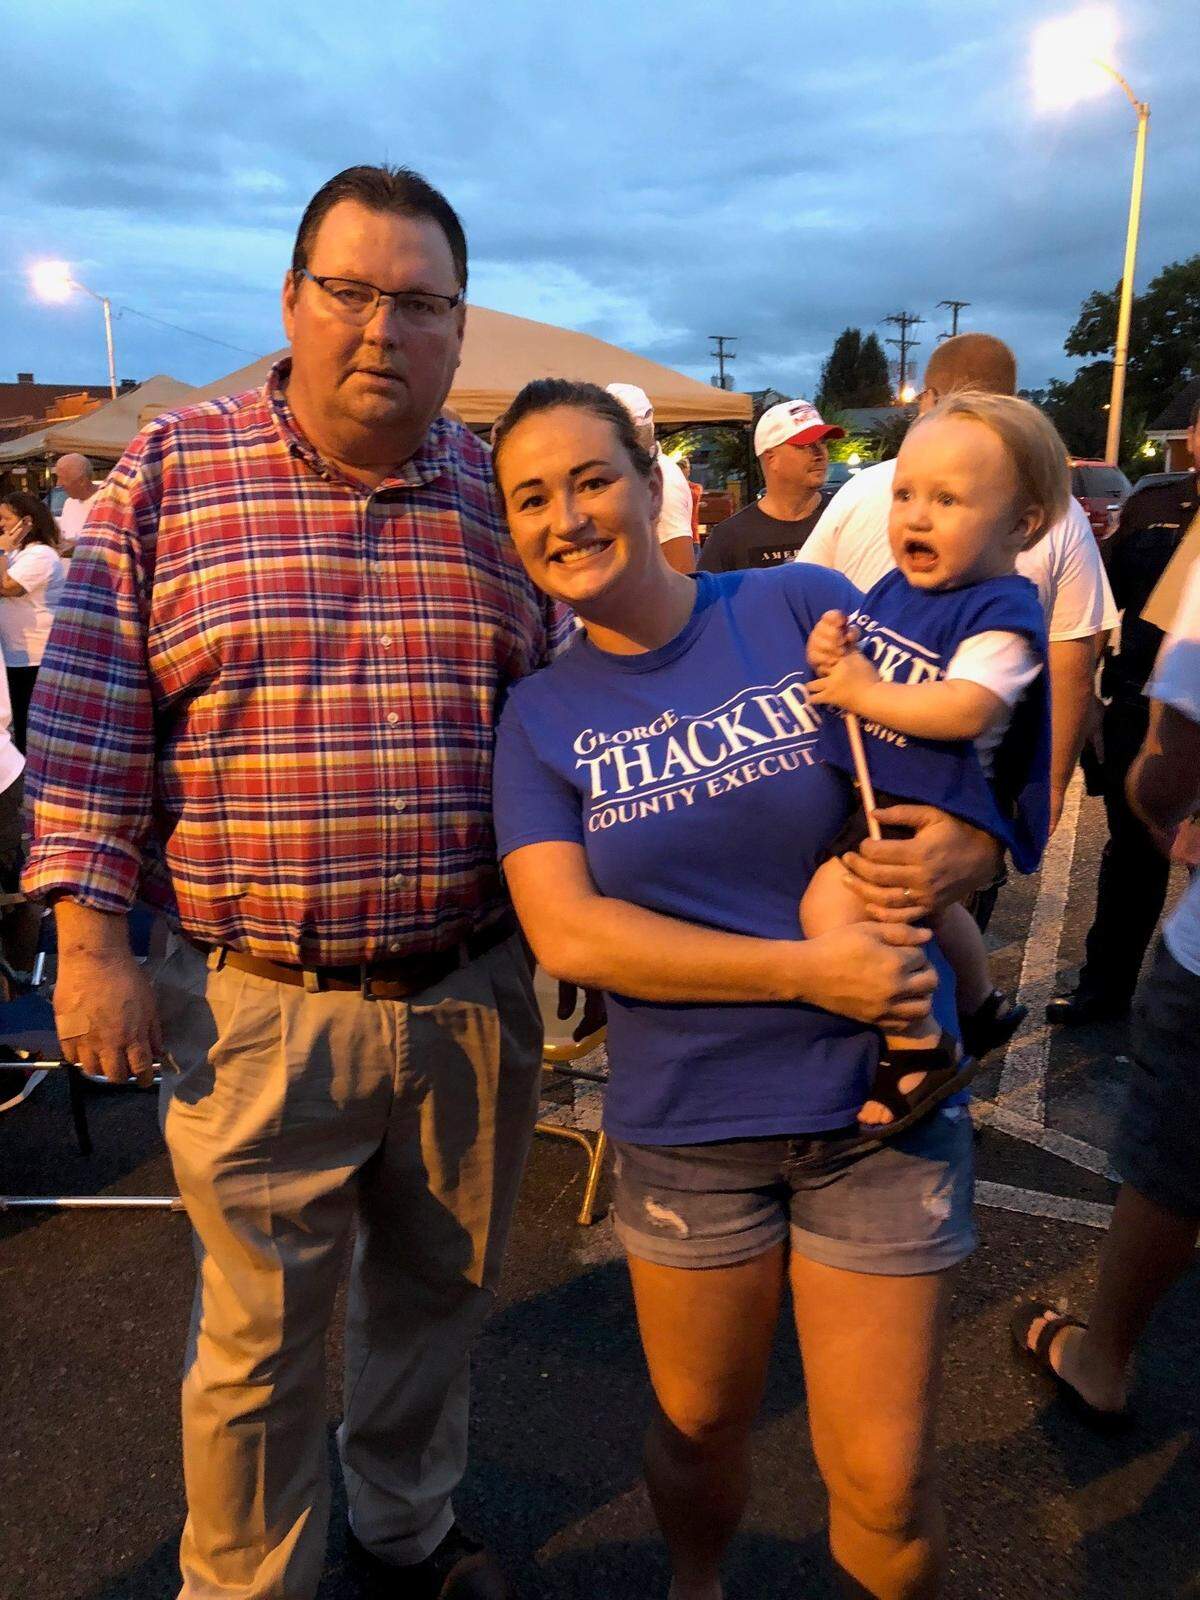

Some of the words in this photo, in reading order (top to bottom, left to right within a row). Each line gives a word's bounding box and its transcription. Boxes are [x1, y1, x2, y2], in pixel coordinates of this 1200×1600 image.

[573, 708, 679, 755] GEORGE
[575, 682, 822, 800] THACKER
[588, 784, 697, 833] COUNTY
[707, 748, 816, 798] EXECUT
